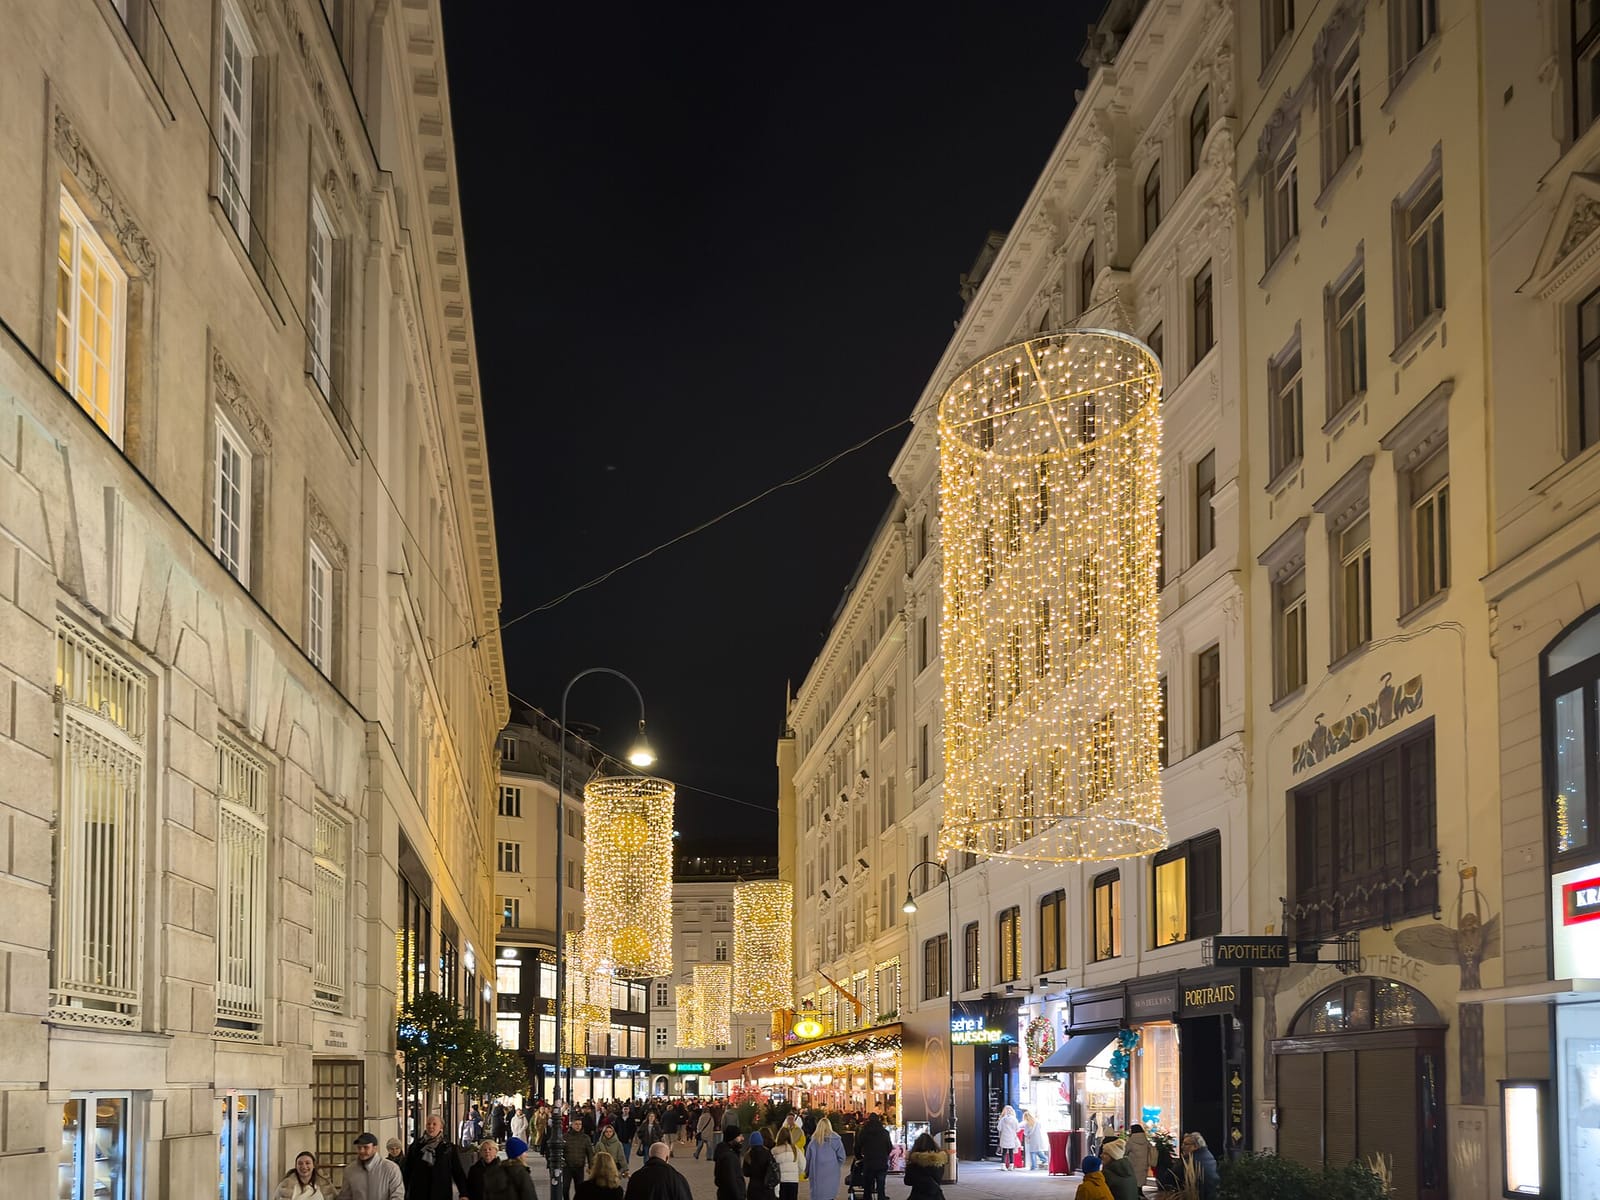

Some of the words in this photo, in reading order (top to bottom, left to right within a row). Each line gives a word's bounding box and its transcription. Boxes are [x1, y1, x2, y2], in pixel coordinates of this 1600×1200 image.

[1217, 944, 1285, 960] APOTHEKE
[1185, 984, 1235, 1007] PORTRAITS
[951, 1029, 1002, 1043] wutscher
